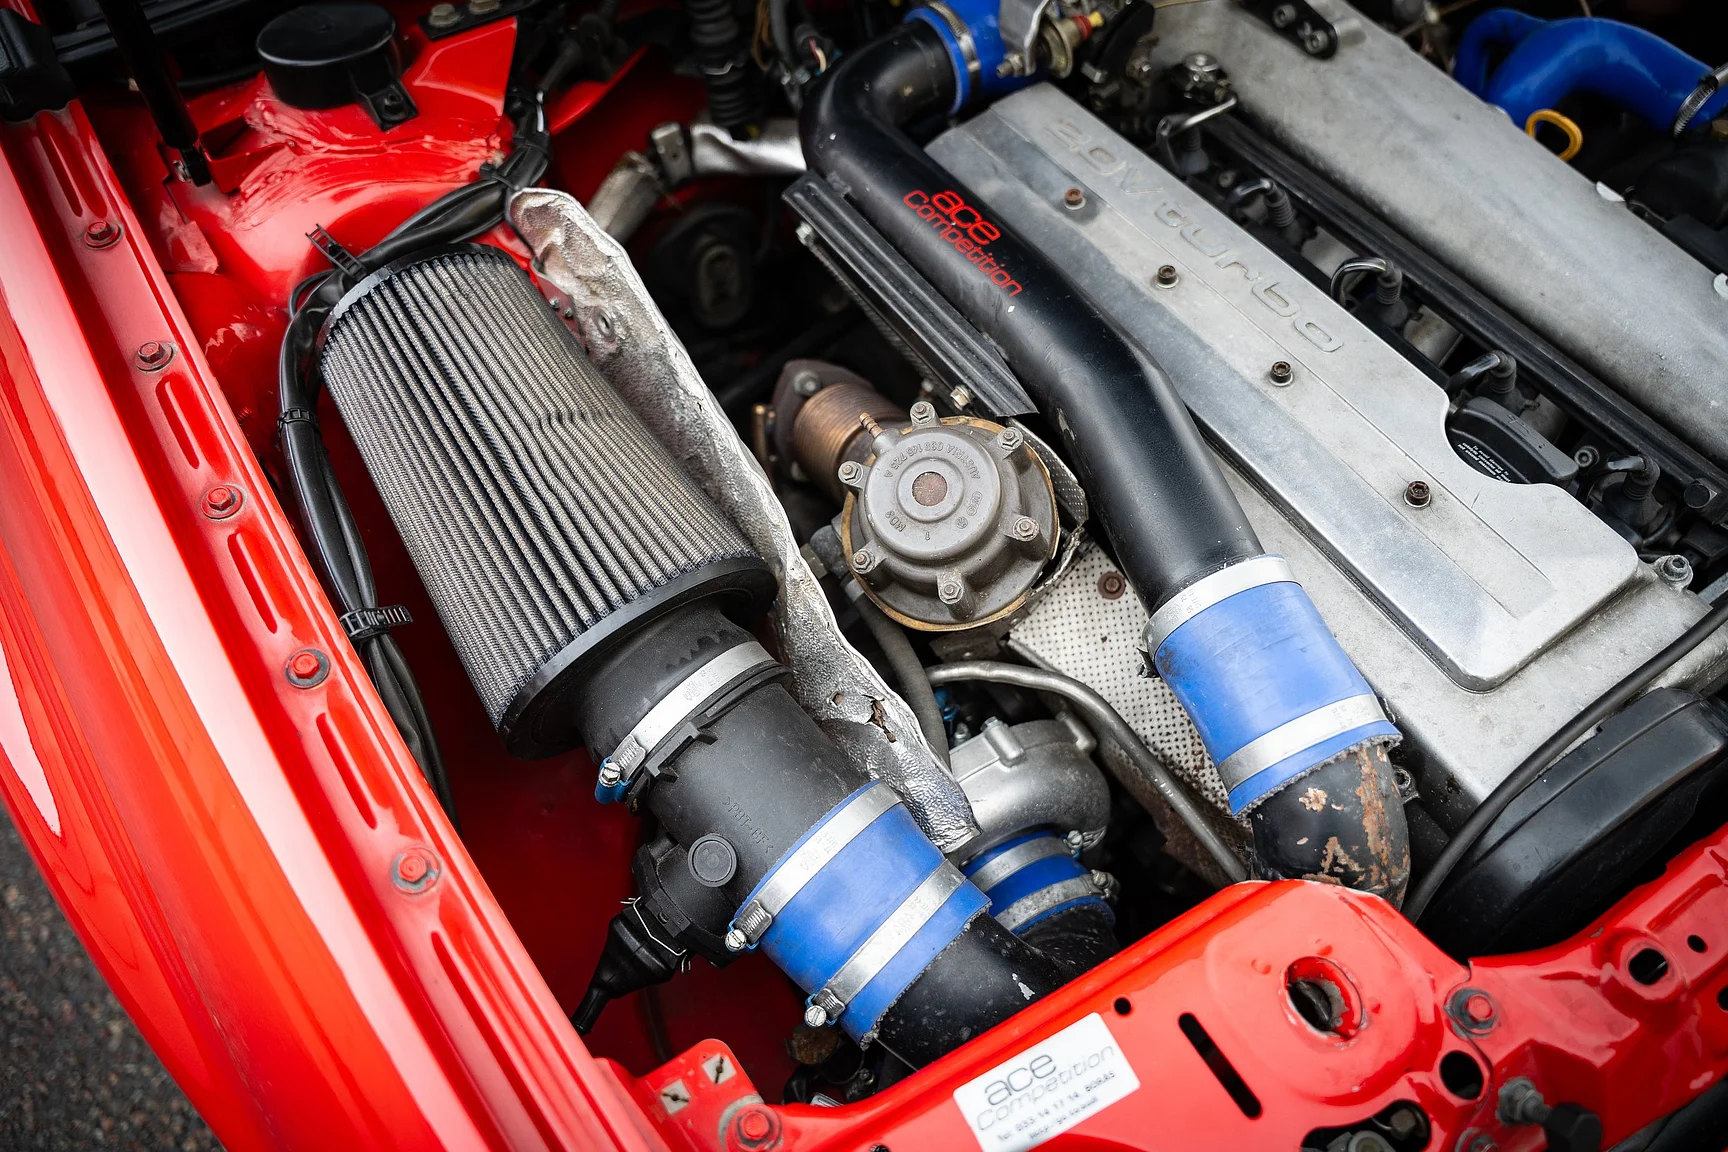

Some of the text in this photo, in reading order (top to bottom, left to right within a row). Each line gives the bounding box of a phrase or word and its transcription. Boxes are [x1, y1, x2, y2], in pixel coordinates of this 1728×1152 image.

[1045, 117, 1164, 194] 20V
[931, 190, 1002, 245] ace
[884, 470, 893, 478] A
[946, 443, 981, 480] AUSTRIA
[985, 1054, 1057, 1106] ace
